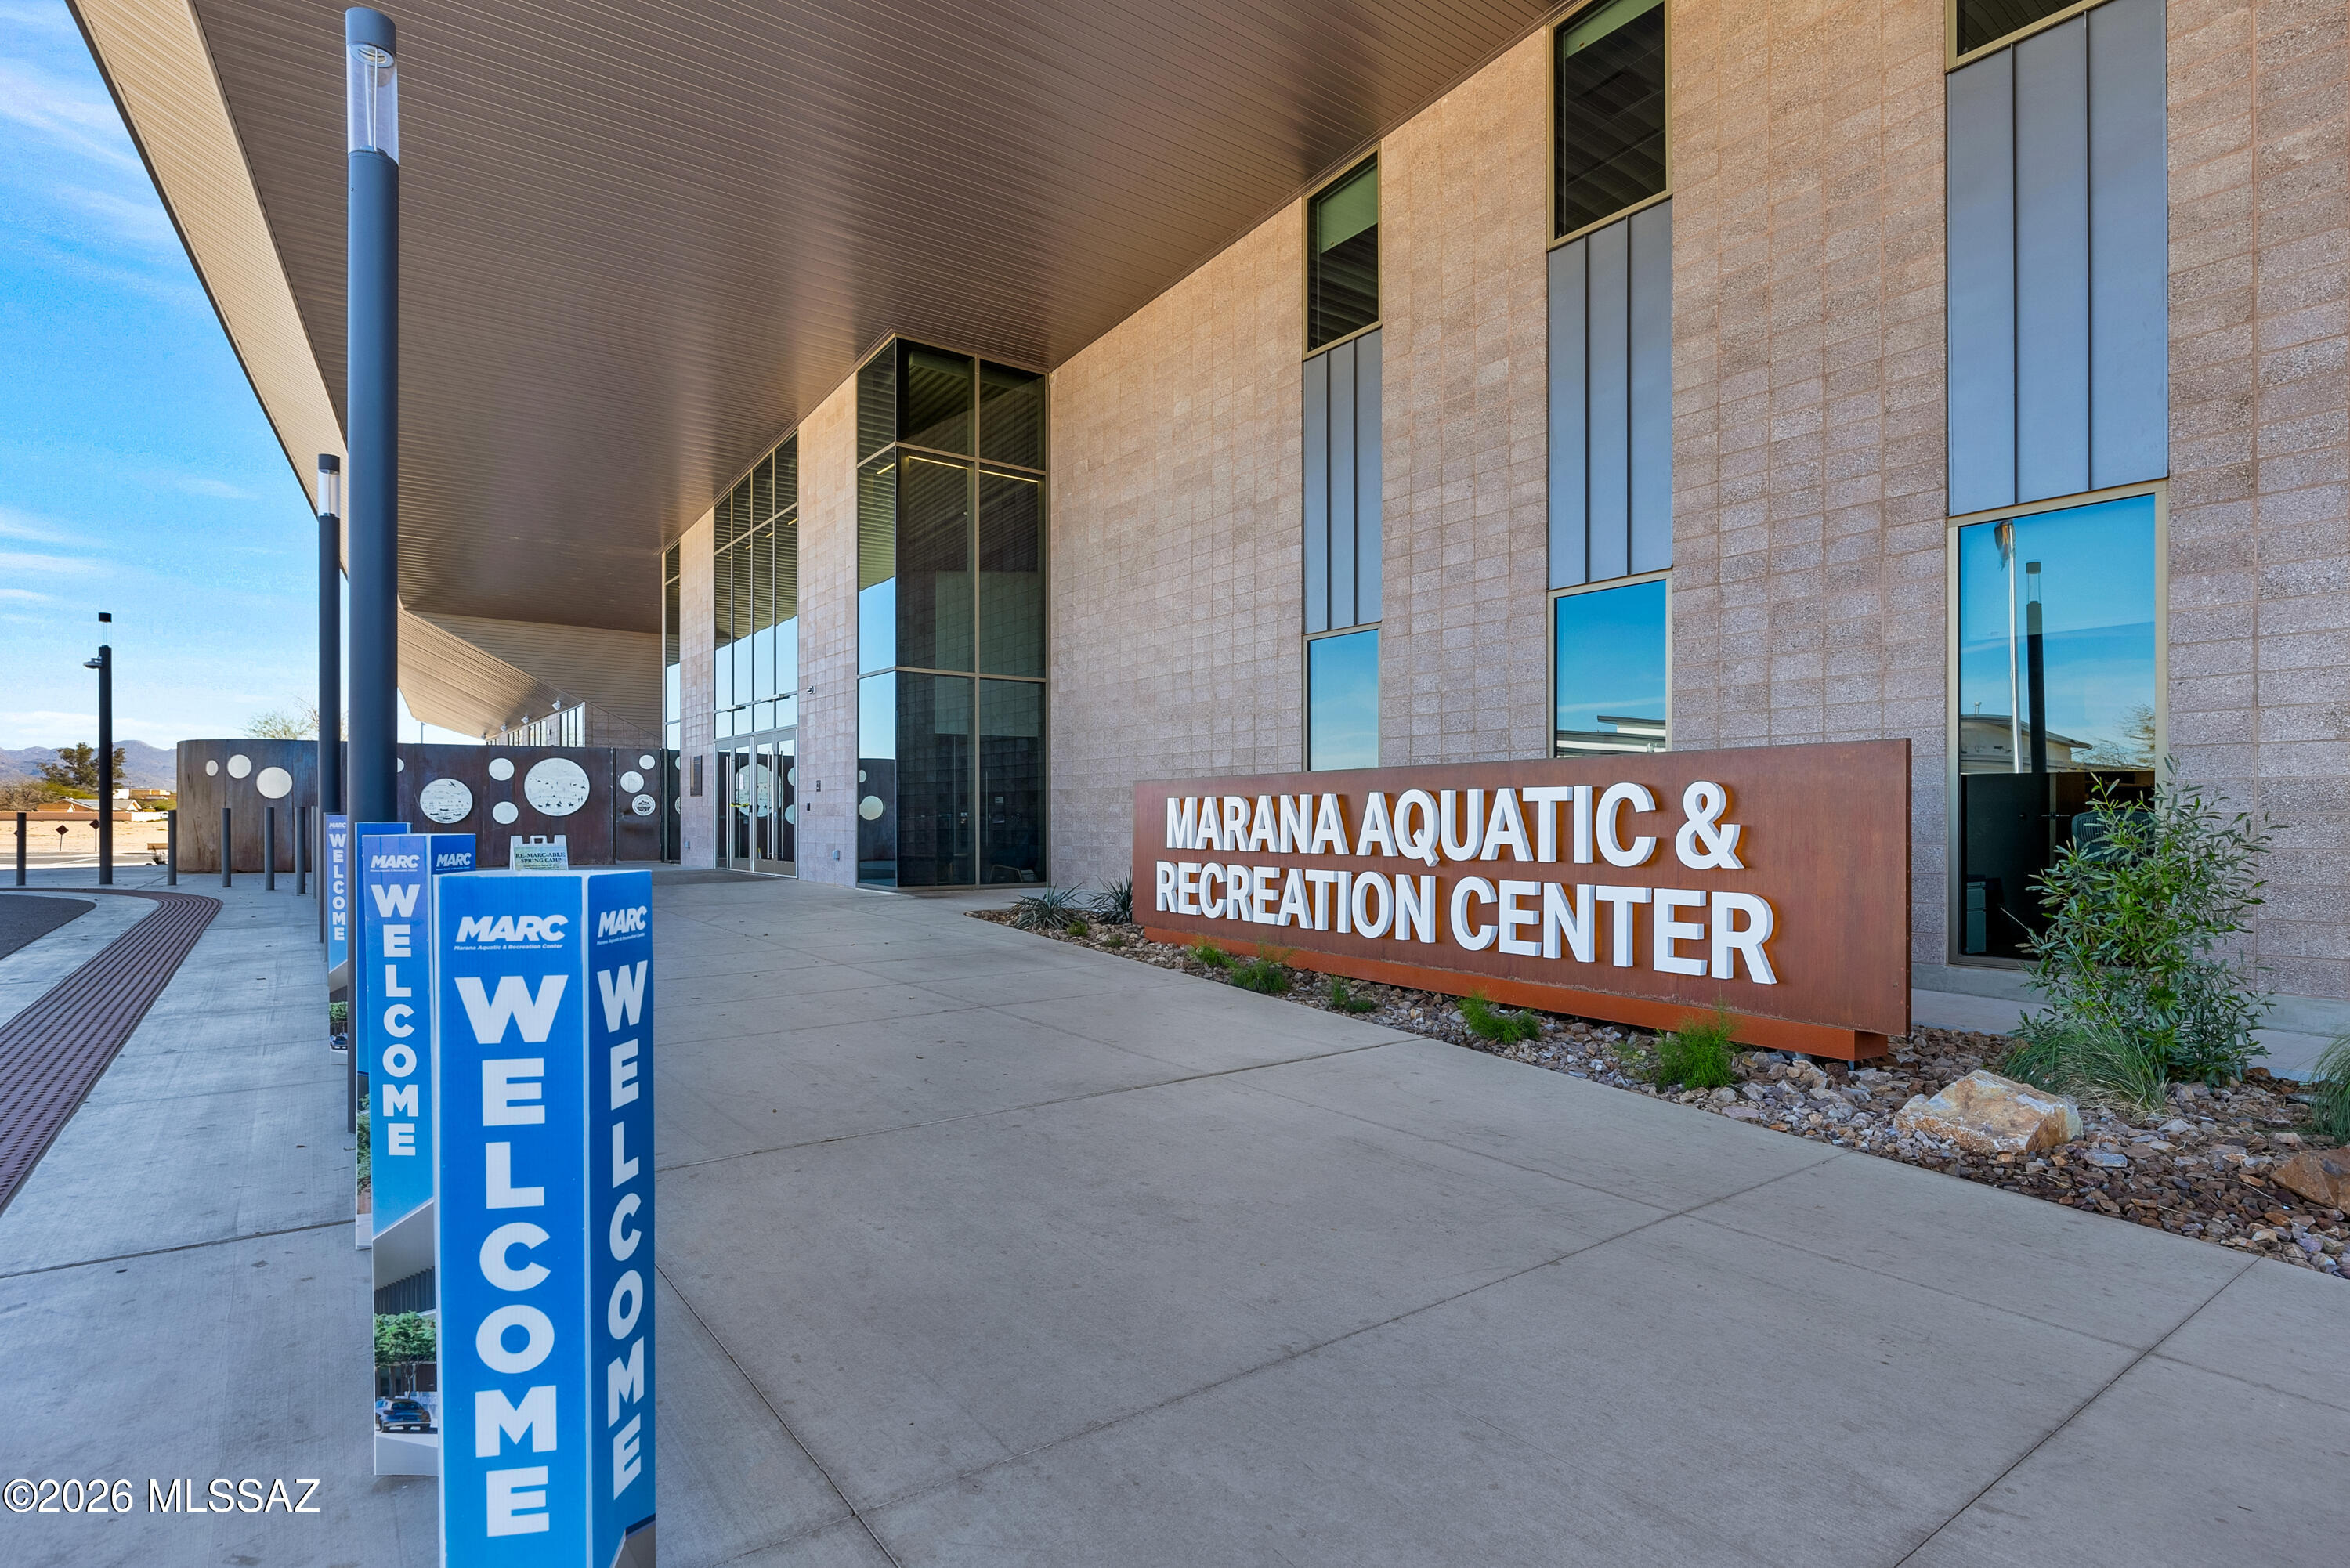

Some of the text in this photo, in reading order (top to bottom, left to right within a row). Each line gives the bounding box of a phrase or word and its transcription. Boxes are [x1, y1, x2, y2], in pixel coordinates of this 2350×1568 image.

[371, 854, 420, 869] MARC
[436, 853, 472, 867] MARC
[1166, 780, 1745, 870] MARANA AQUATIC &
[329, 833, 347, 941] WELCOME
[455, 914, 569, 942] MARC
[598, 905, 647, 938] MARC
[1155, 860, 1778, 986] RECREATION CENTER
[370, 884, 421, 1156] WELCOME
[454, 974, 569, 1538] WELCOME
[597, 959, 649, 1502] WELCOME
